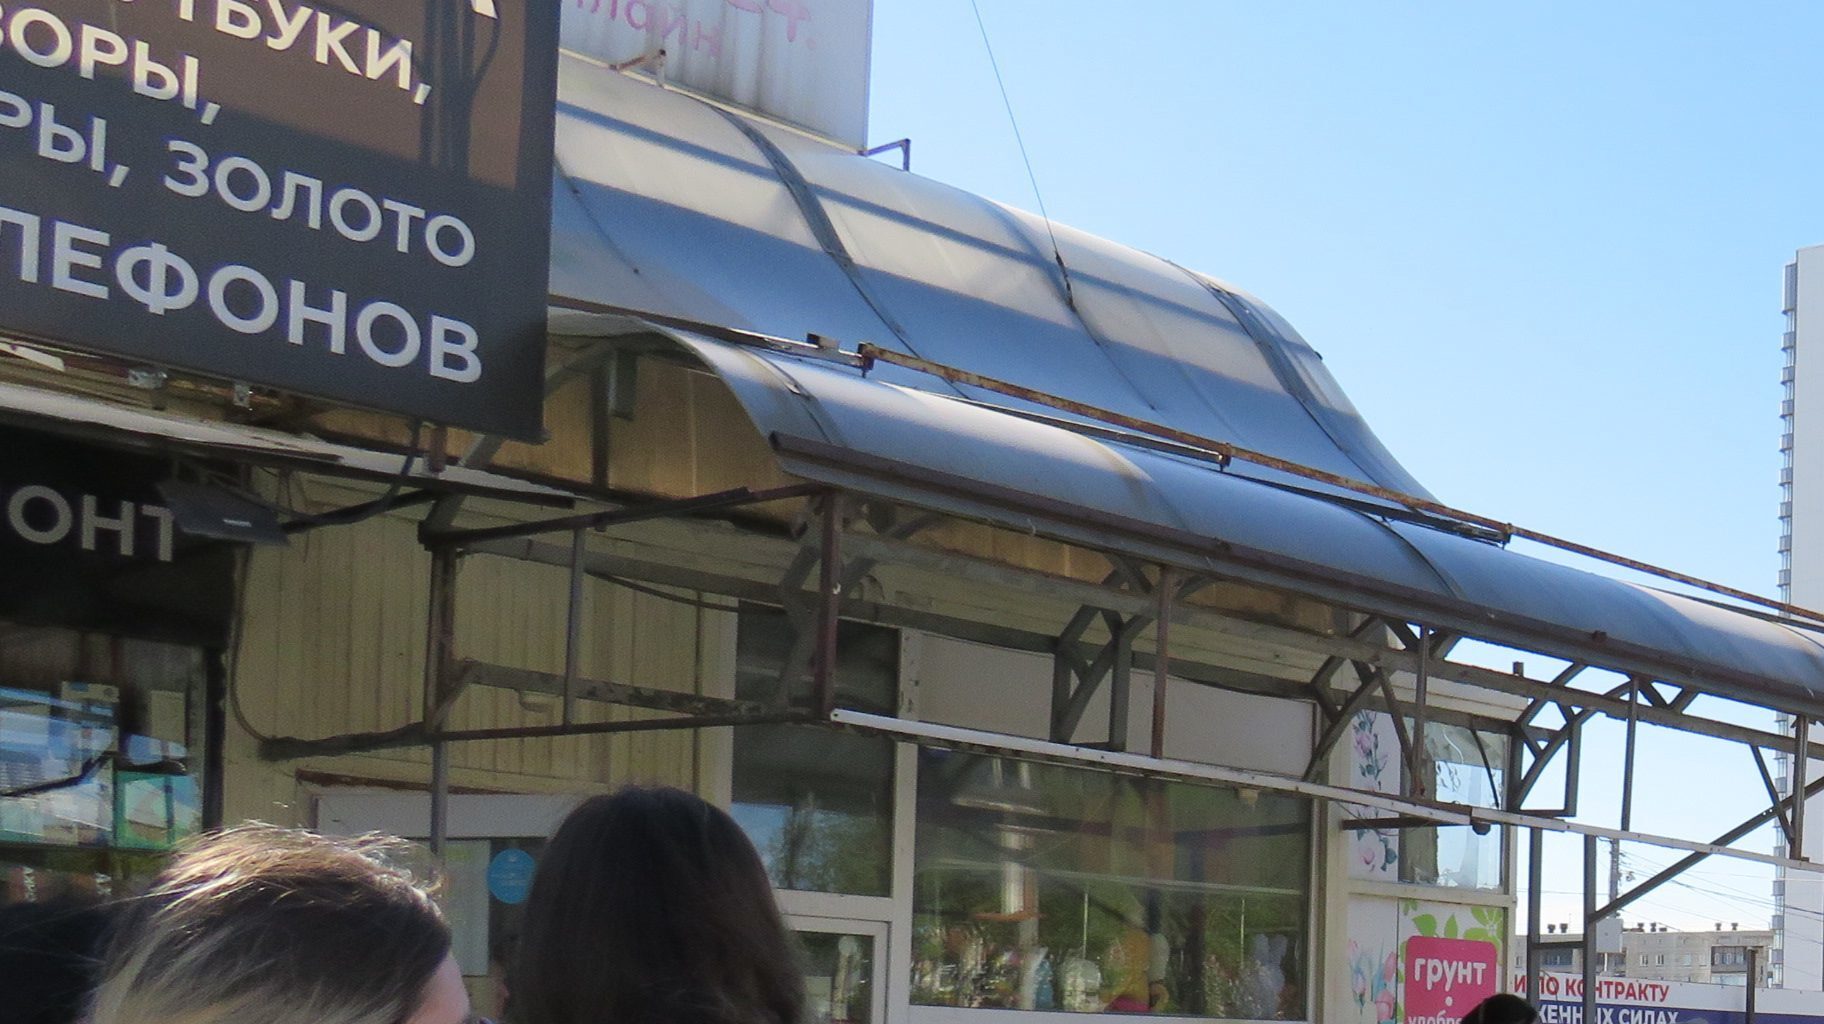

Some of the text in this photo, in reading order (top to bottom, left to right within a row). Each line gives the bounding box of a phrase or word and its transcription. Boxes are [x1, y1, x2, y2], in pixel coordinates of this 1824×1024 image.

[0, 7, 221, 125] ОРЫ,
[164, 140, 476, 267] ЗОЛОТО
[1414, 957, 1487, 991] грунт
